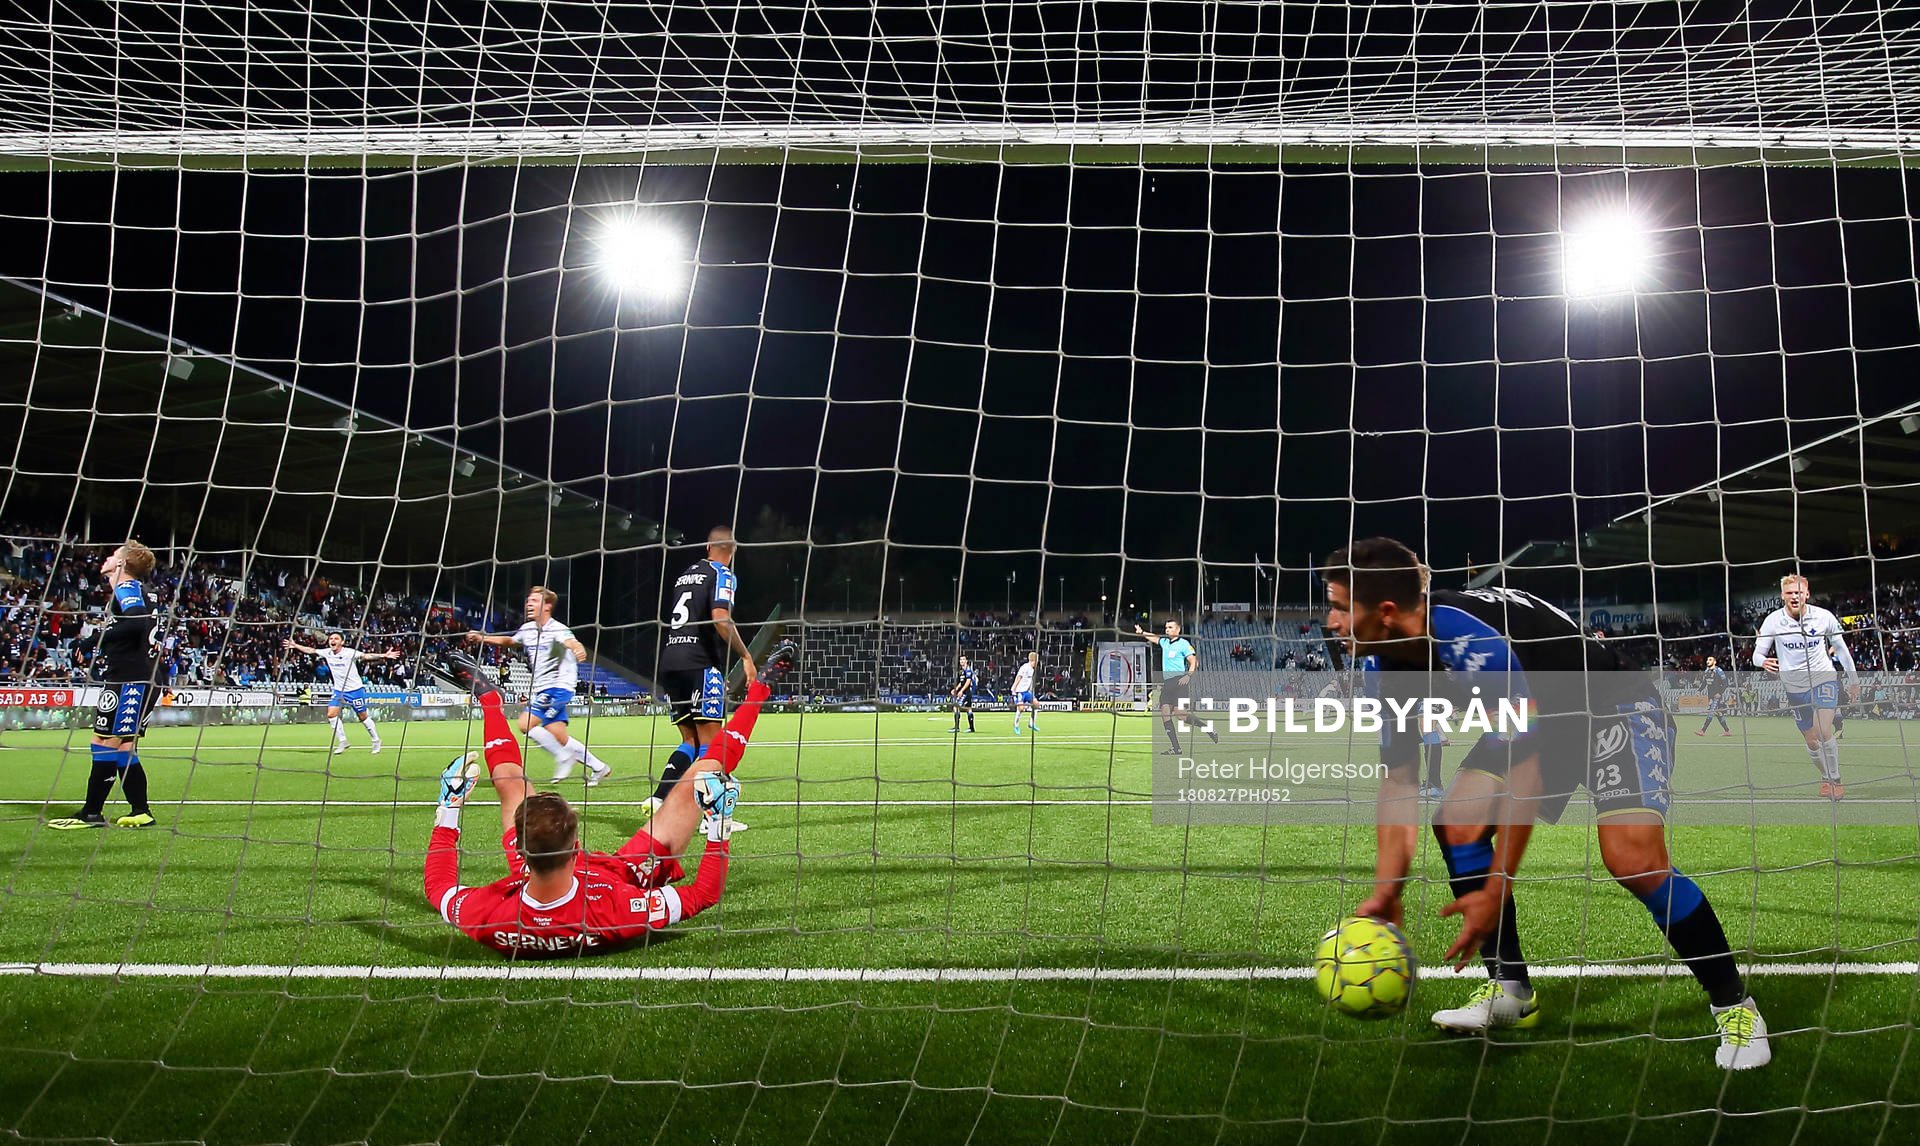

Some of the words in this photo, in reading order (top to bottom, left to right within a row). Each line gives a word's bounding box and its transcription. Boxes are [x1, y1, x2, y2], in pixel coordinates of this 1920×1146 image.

[671, 591, 692, 630] 5
[28, 693, 48, 705] AB
[96, 715, 108, 727] 20
[1596, 764, 1622, 792] 23
[494, 931, 600, 951] SERNEKE
